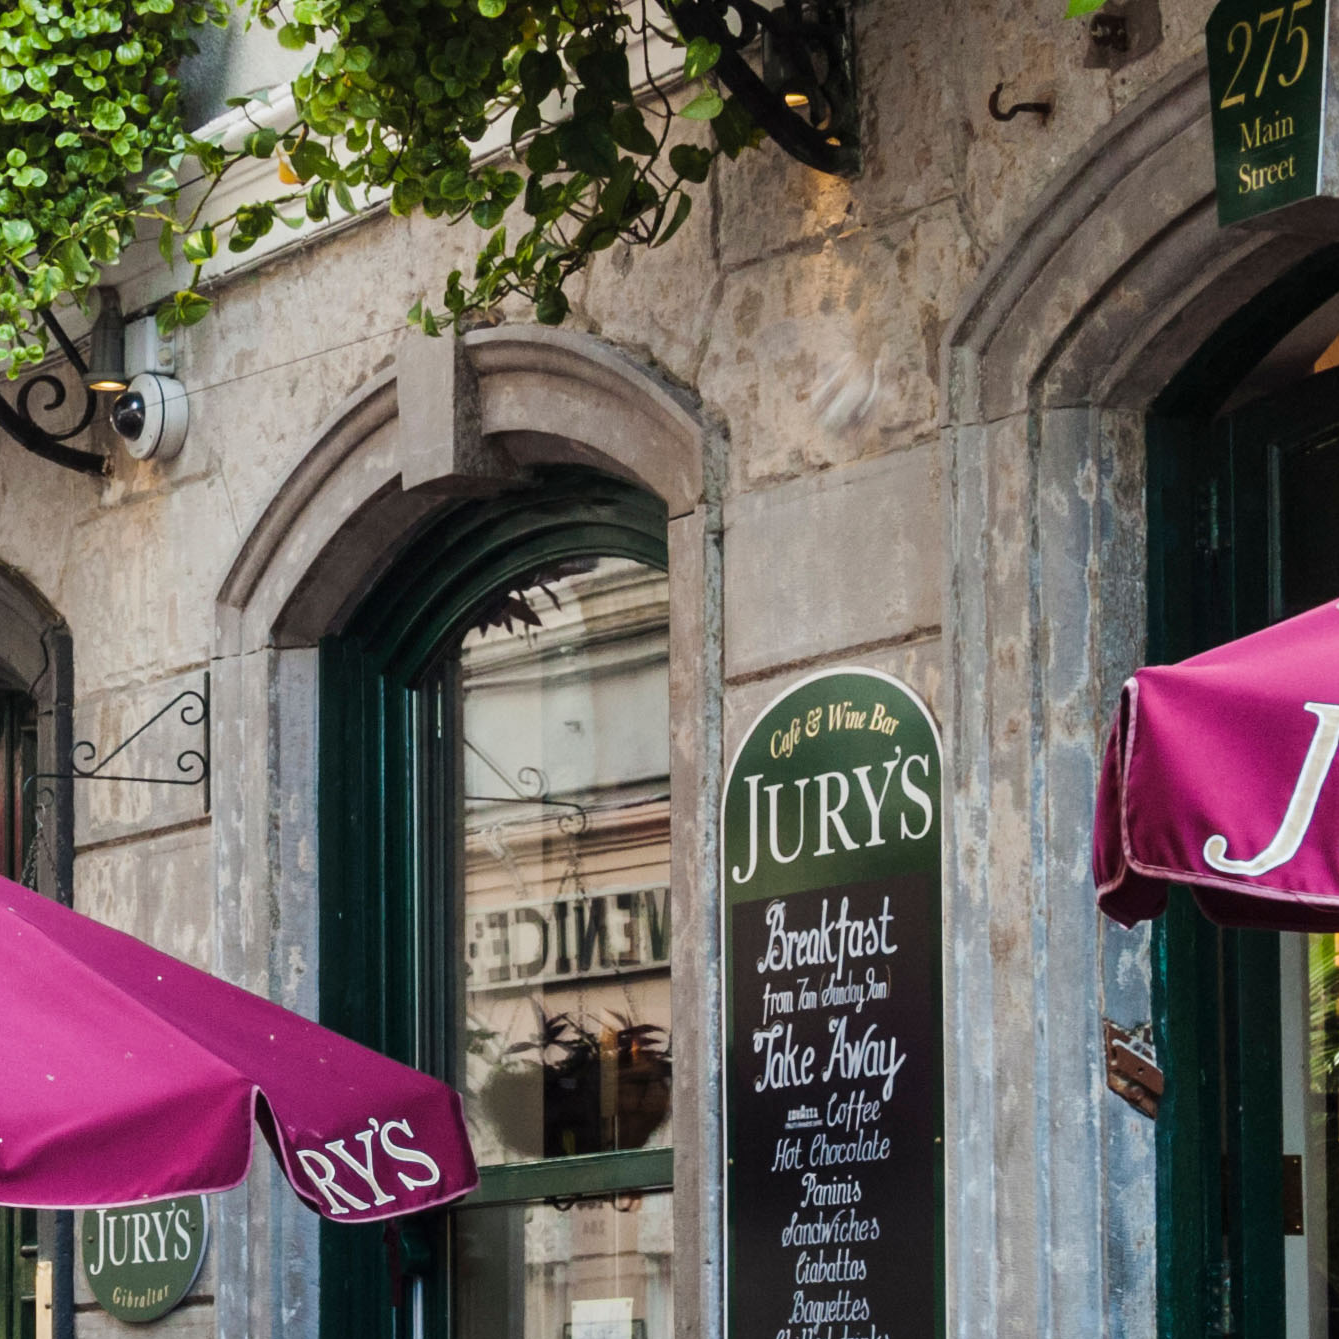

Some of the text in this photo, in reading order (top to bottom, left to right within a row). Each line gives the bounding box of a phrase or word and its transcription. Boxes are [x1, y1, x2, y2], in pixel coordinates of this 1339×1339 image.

[1220, 0, 1311, 109] 275
[1240, 110, 1295, 152] Main
[1238, 155, 1296, 195] Street
[770, 701, 900, 759] Café & Wine Bar
[731, 745, 934, 885] JURY'S
[757, 896, 898, 979] Breakfast
[762, 982, 794, 1026] from
[796, 977, 818, 1012] 7am
[753, 1015, 906, 1102] Take Away
[827, 1089, 882, 1133] Coffee
[296, 1117, 441, 1215] RY'S
[771, 1132, 891, 1172] Hot Chocolate
[800, 1171, 863, 1208] Paninis
[89, 1202, 192, 1275] JURY'S
[782, 1208, 880, 1248] Sandwiches
[794, 1248, 867, 1285] Ciabattas
[112, 1285, 171, 1308] Gibraltar
[788, 1289, 870, 1333] Baguettes
